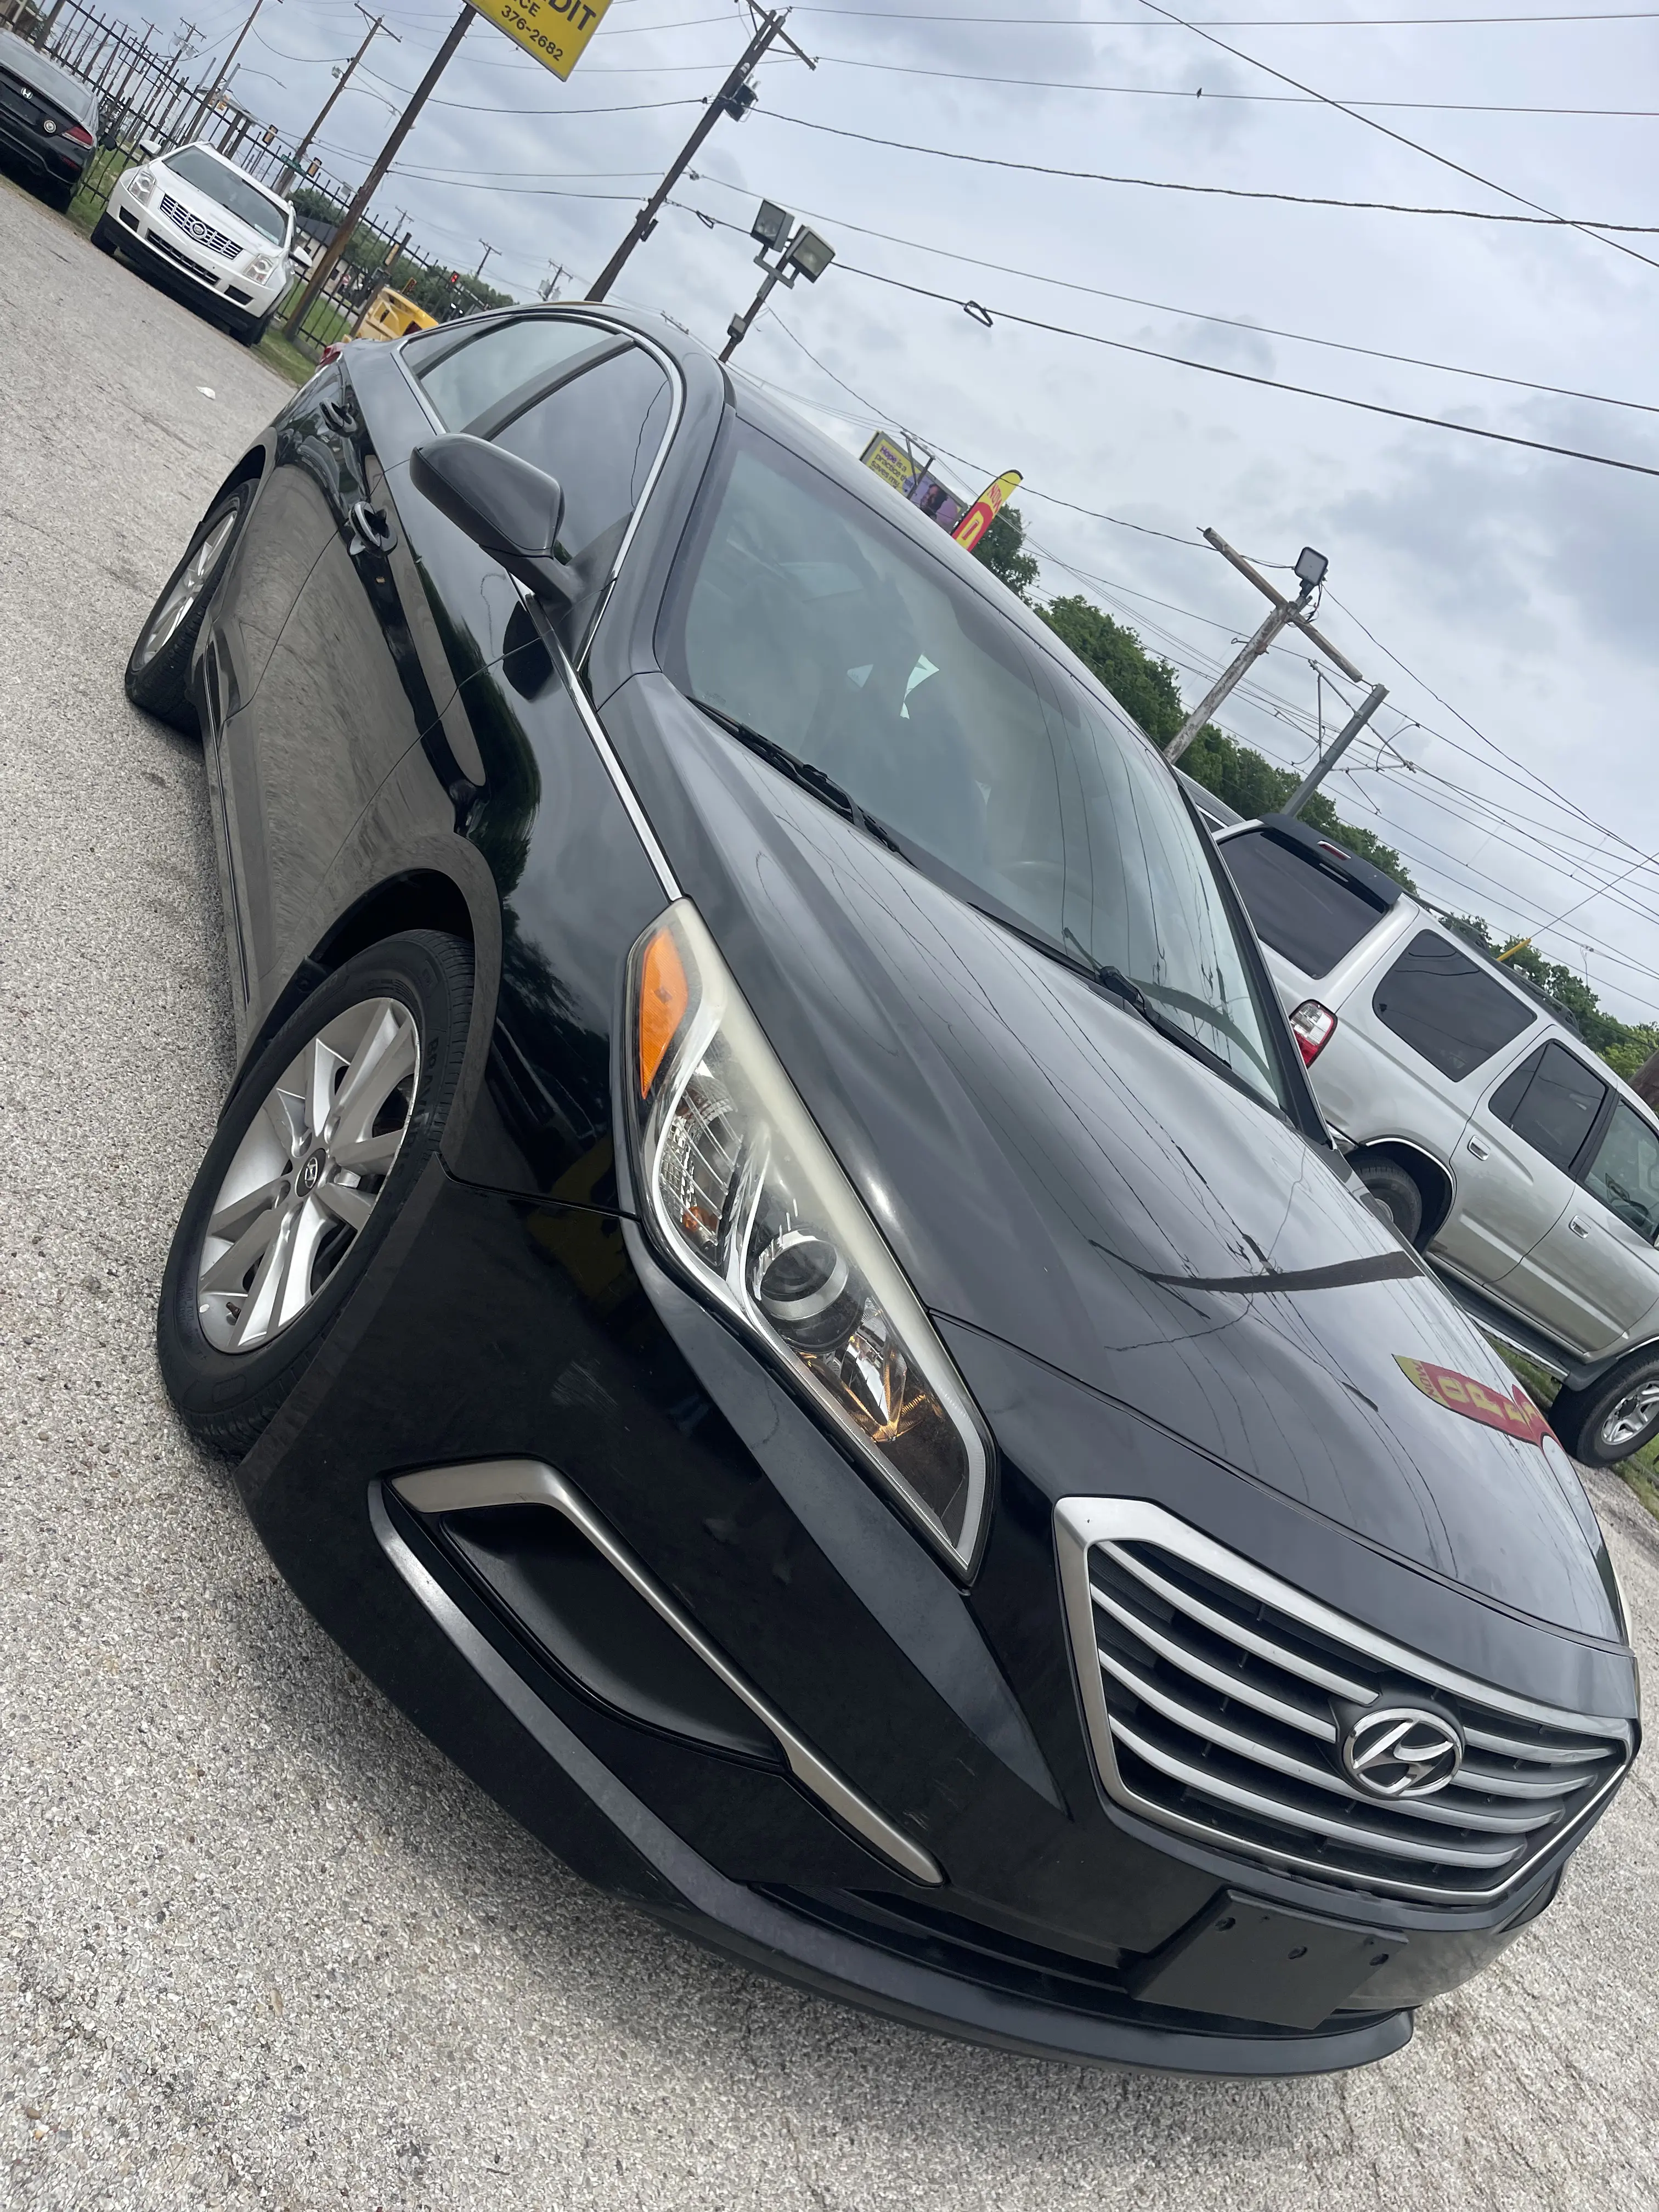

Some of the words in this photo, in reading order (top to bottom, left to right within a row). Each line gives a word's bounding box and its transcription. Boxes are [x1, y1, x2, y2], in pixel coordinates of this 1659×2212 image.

[514, 0, 541, 17] CE
[543, 0, 596, 31] DIT
[501, 5, 563, 61] 376-2682
[871, 461, 889, 478] saves
[875, 454, 901, 477] practice
[987, 483, 1002, 514] NOW
